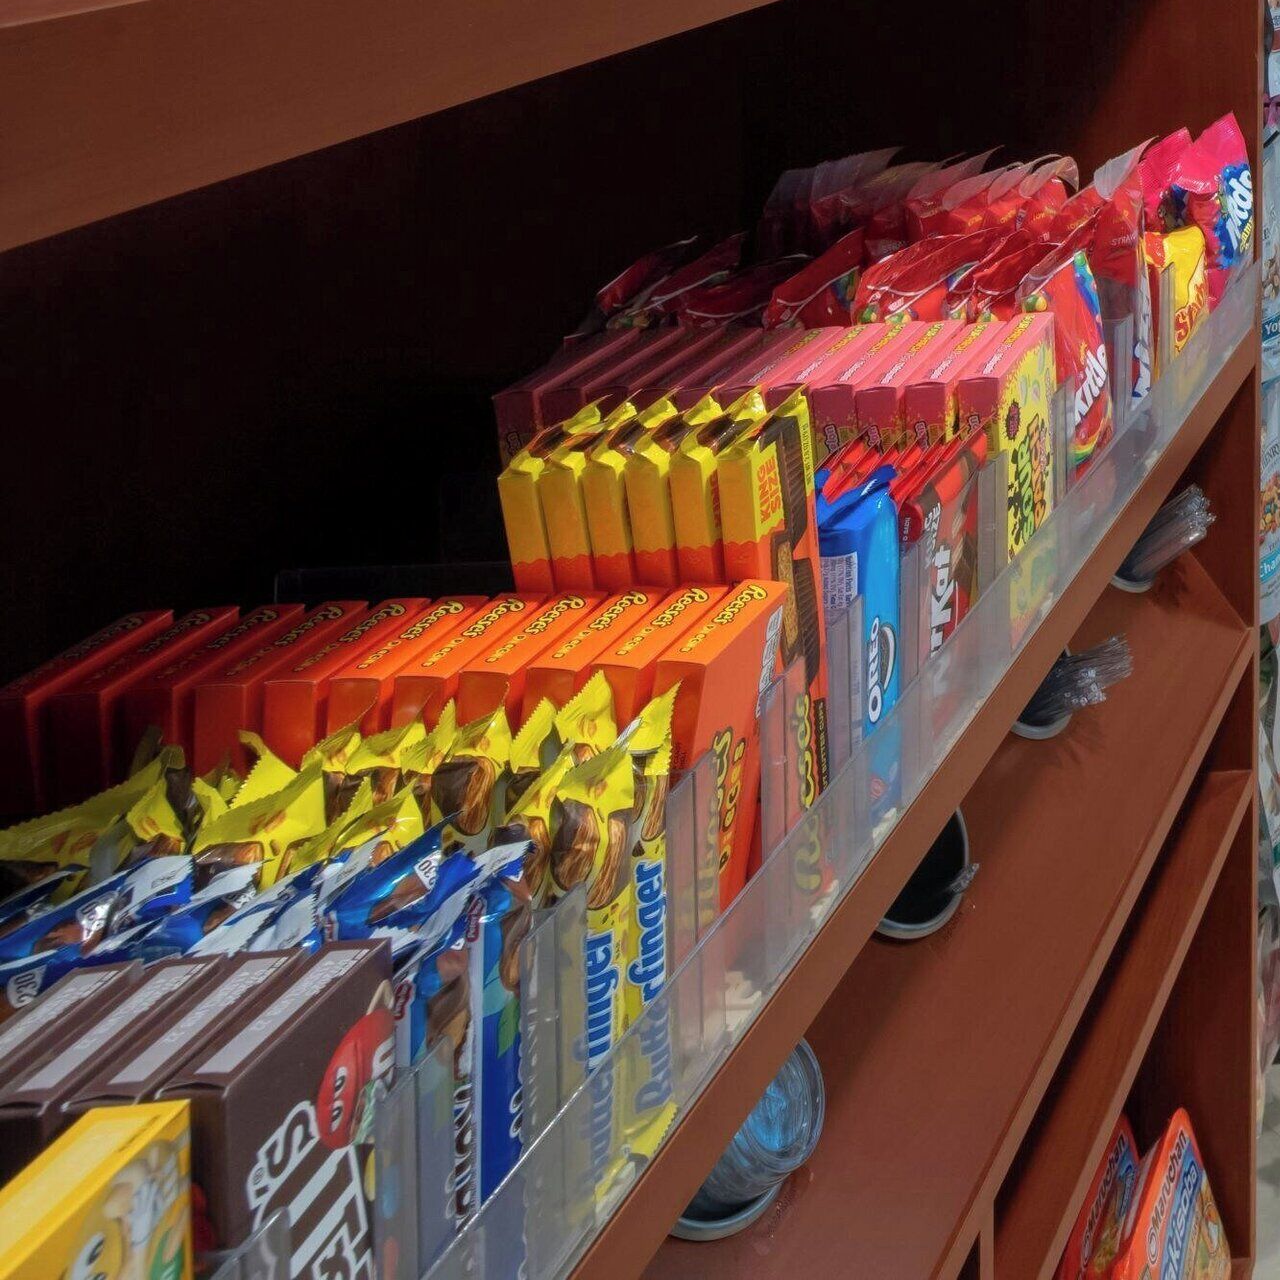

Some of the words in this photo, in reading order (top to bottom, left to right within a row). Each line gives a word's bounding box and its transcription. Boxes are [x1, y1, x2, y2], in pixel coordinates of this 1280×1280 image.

[757, 463, 771, 525] KING
[766, 456, 782, 516] SIZE
[1017, 435, 1035, 539] SOUR
[1027, 414, 1048, 529] PATCH
[399, 600, 465, 642] Reese's
[461, 598, 526, 640] Reese's
[524, 594, 587, 636] Reese's
[588, 590, 649, 632] Reese's
[650, 587, 712, 630] Reese's
[712, 583, 769, 627] Reese's
[868, 616, 882, 724] OREO
[1151, 1129, 1188, 1231] Maruchan
[1164, 1159, 1199, 1280] akisoba
